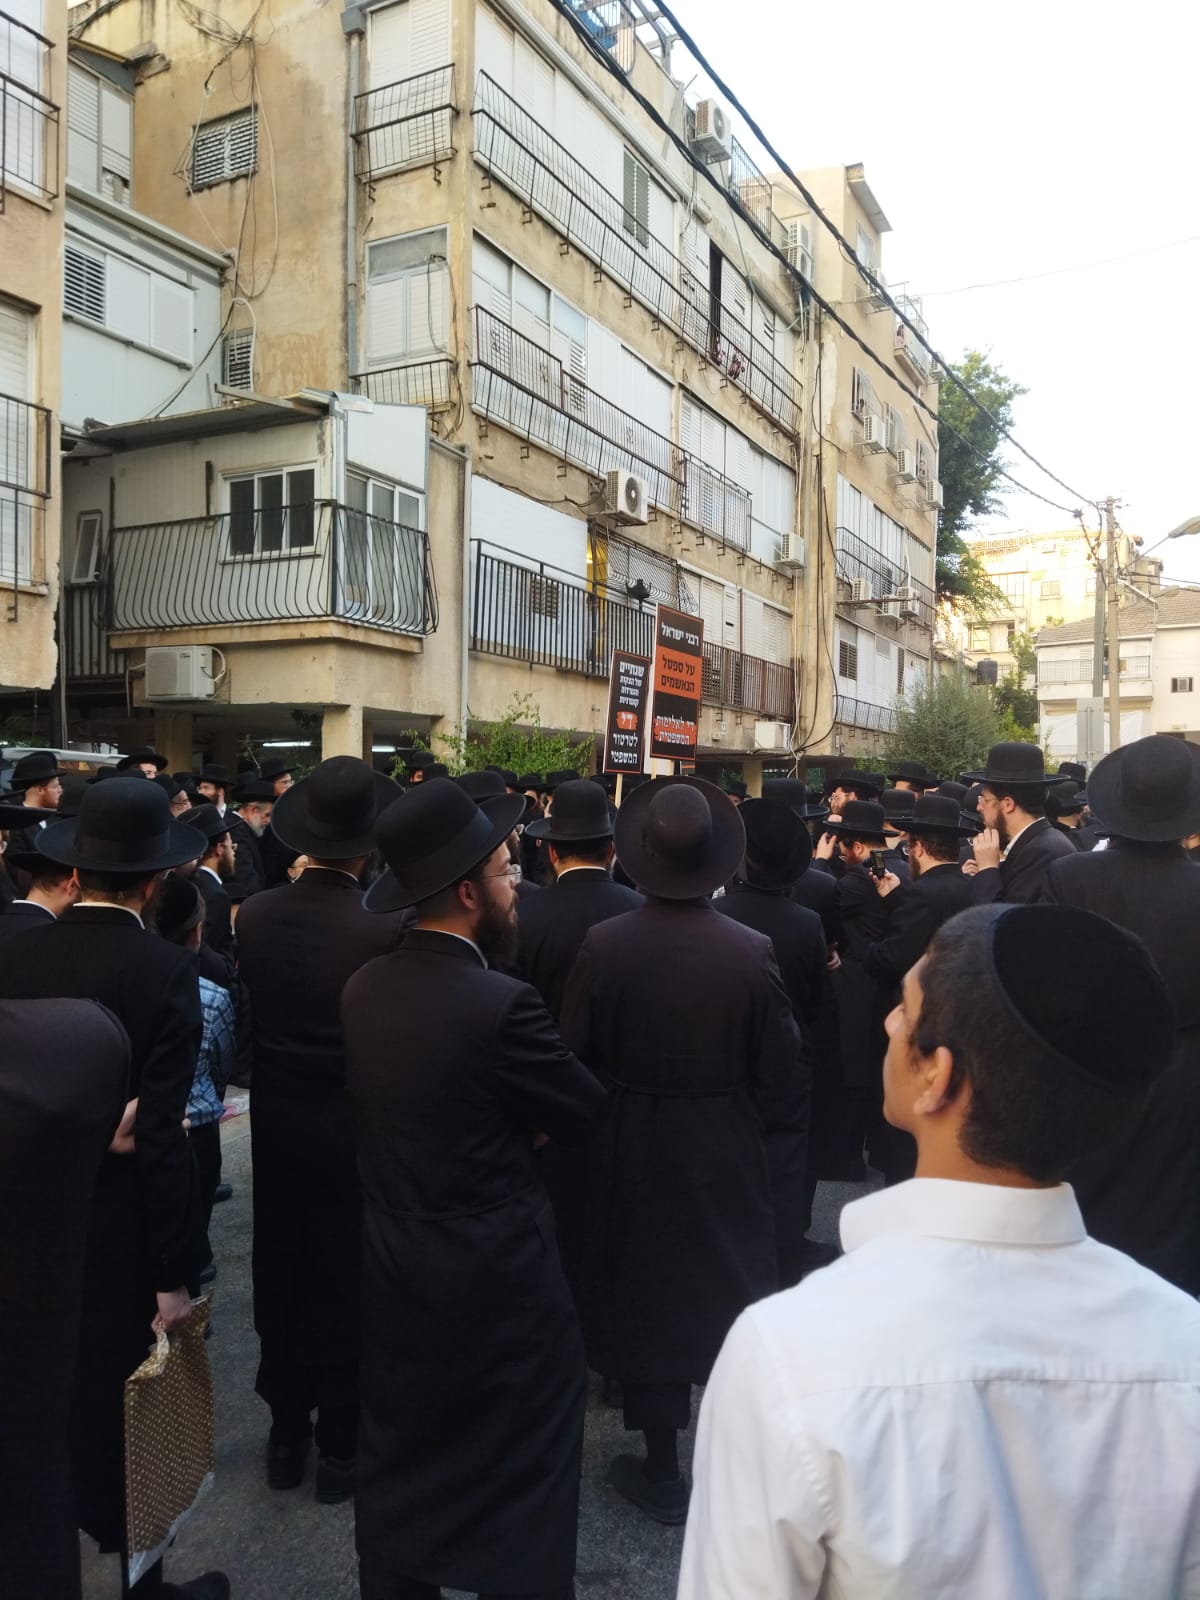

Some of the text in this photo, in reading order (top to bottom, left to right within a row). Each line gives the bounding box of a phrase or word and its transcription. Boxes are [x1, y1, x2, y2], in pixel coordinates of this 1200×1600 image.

[661, 621, 699, 647] רבני ישראל
[619, 661, 645, 677] שנתיים
[662, 654, 696, 676] על ספסל
[661, 674, 695, 694] הנאשמים
[656, 714, 685, 730] לאלימות
[612, 732, 639, 748] לטרטור
[610, 750, 638, 765] המשפטי
